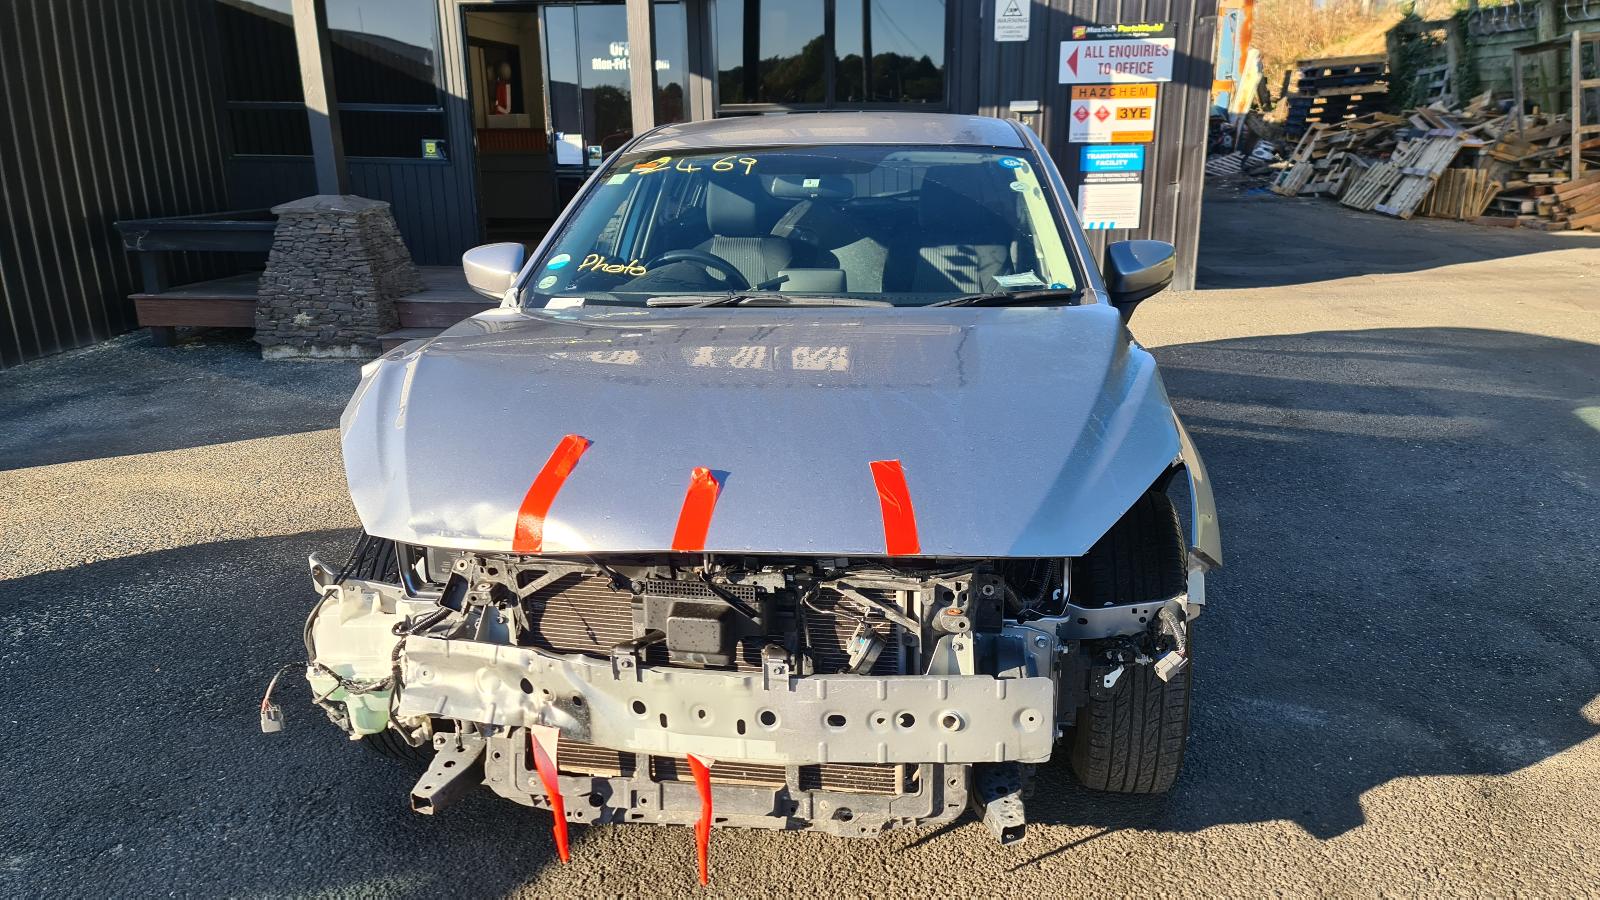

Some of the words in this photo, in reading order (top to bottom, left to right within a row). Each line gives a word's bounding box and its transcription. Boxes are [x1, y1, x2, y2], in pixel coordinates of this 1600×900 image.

[1084, 46, 1104, 58] ALL
[1108, 44, 1169, 58] ENQUIRIES
[592, 58, 627, 70] Mon-Fri
[1098, 62, 1111, 75] TO
[1115, 61, 1154, 74] OFFICE
[1079, 87, 1148, 97] HAZCHEM
[1120, 108, 1147, 119] 3YE
[577, 254, 646, 276] Photo
